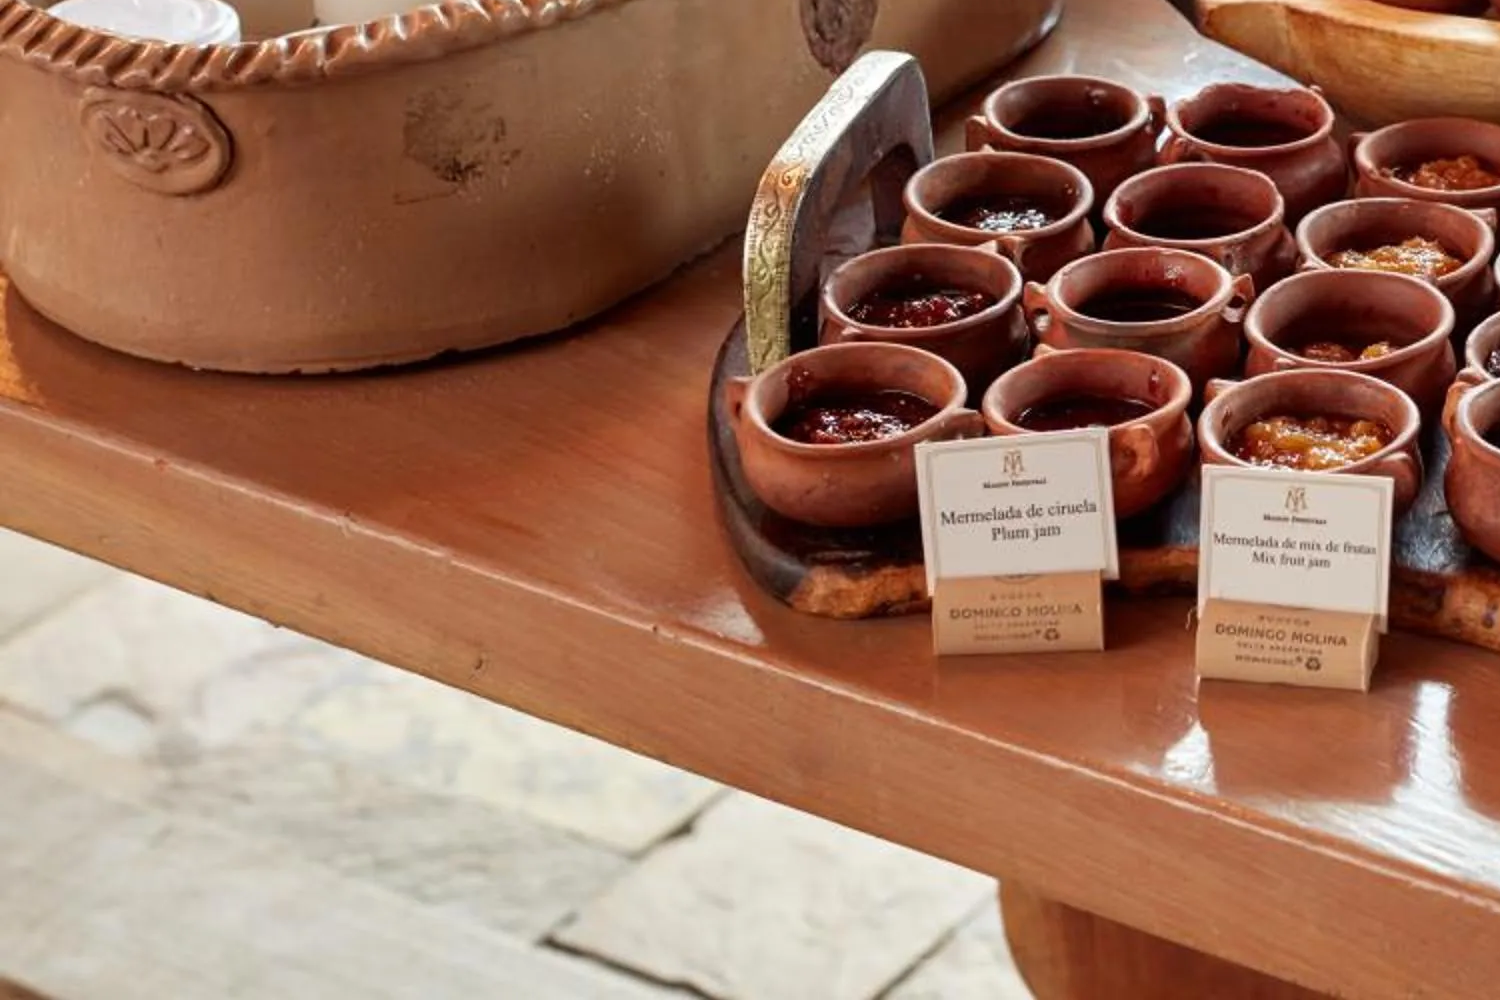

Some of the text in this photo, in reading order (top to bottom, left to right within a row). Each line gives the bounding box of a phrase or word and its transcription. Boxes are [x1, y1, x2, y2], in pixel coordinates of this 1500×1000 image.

[941, 499, 1097, 526] Mermelada de ciruela
[991, 524, 1061, 541] Plum jam
[1213, 532, 1377, 555] Mermelada de mix de frutas
[1252, 551, 1331, 573] Mix fruit jam
[949, 603, 1082, 620] DOMINGO MOLINA
[1215, 623, 1347, 646] DOMINGO MOLINA
